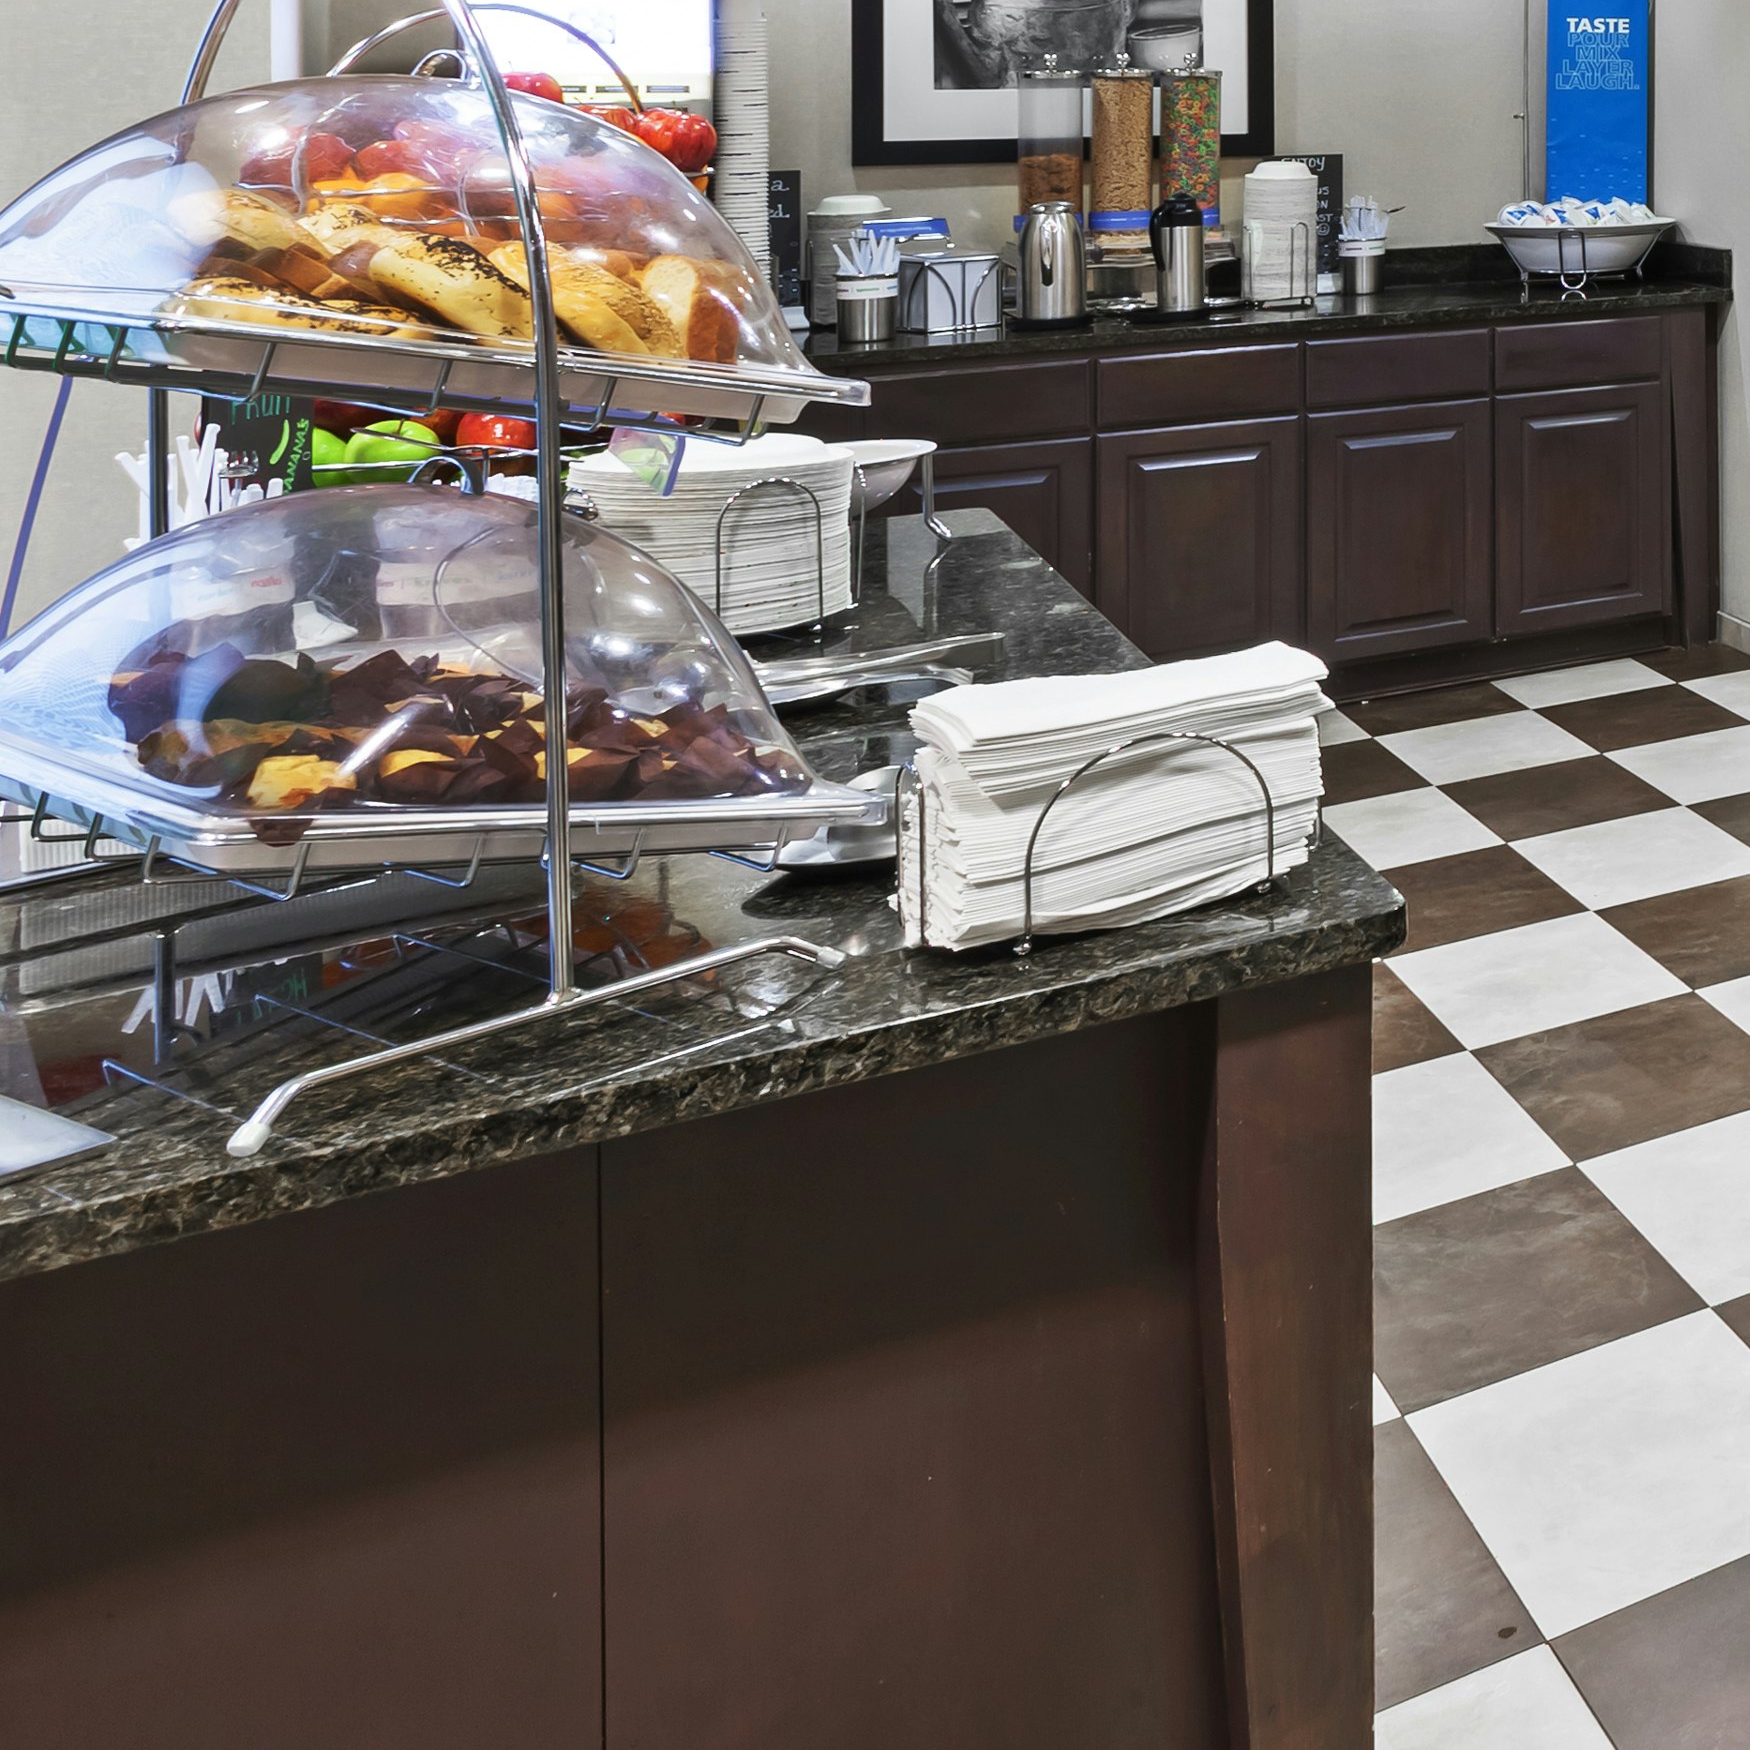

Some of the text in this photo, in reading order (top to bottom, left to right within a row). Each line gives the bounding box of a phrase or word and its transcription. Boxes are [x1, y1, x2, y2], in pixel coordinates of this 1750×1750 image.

[1566, 18, 1630, 33] TASTE
[1568, 31, 1630, 47] POUR
[1575, 45, 1621, 61] MIX
[1563, 59, 1633, 76] LAYER
[1555, 73, 1640, 90] LAUGH.
